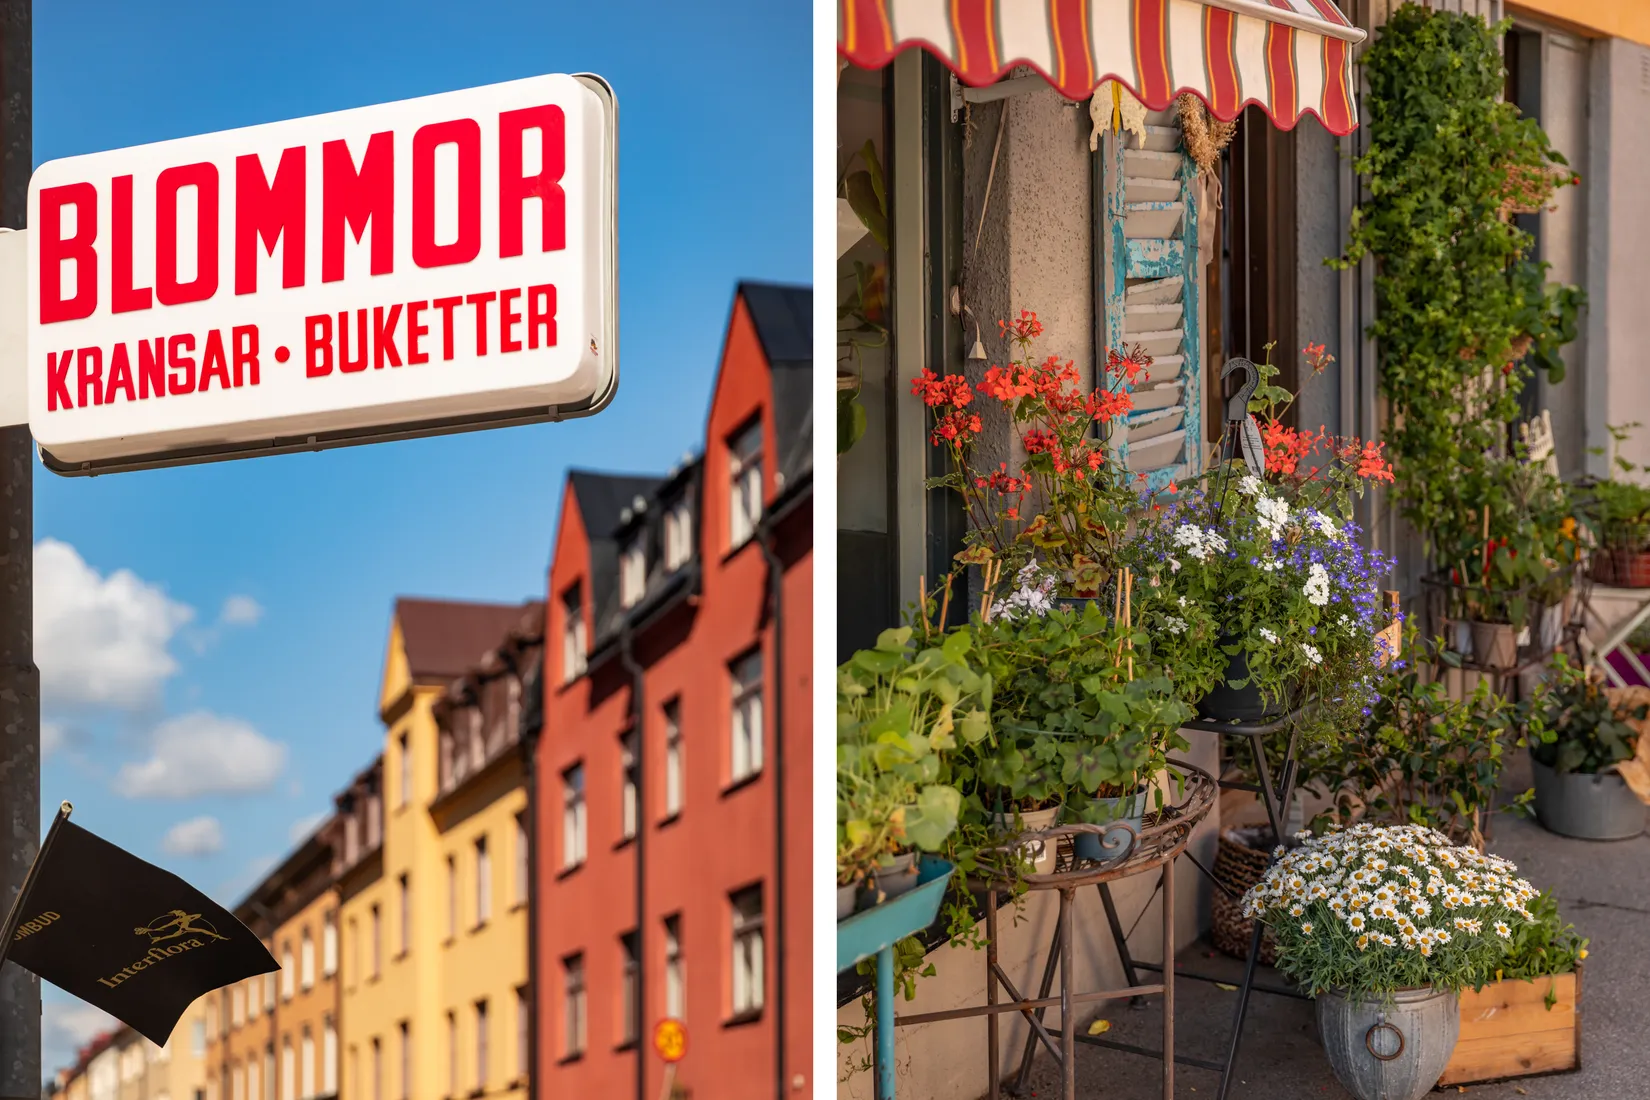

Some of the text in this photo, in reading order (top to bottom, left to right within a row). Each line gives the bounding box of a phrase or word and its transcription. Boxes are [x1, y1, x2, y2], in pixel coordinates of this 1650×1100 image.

[40, 104, 566, 324] BLOMMOR
[47, 323, 260, 411] KRANSAR
[305, 284, 557, 378] BUKETTER
[97, 938, 205, 989] Interflora
